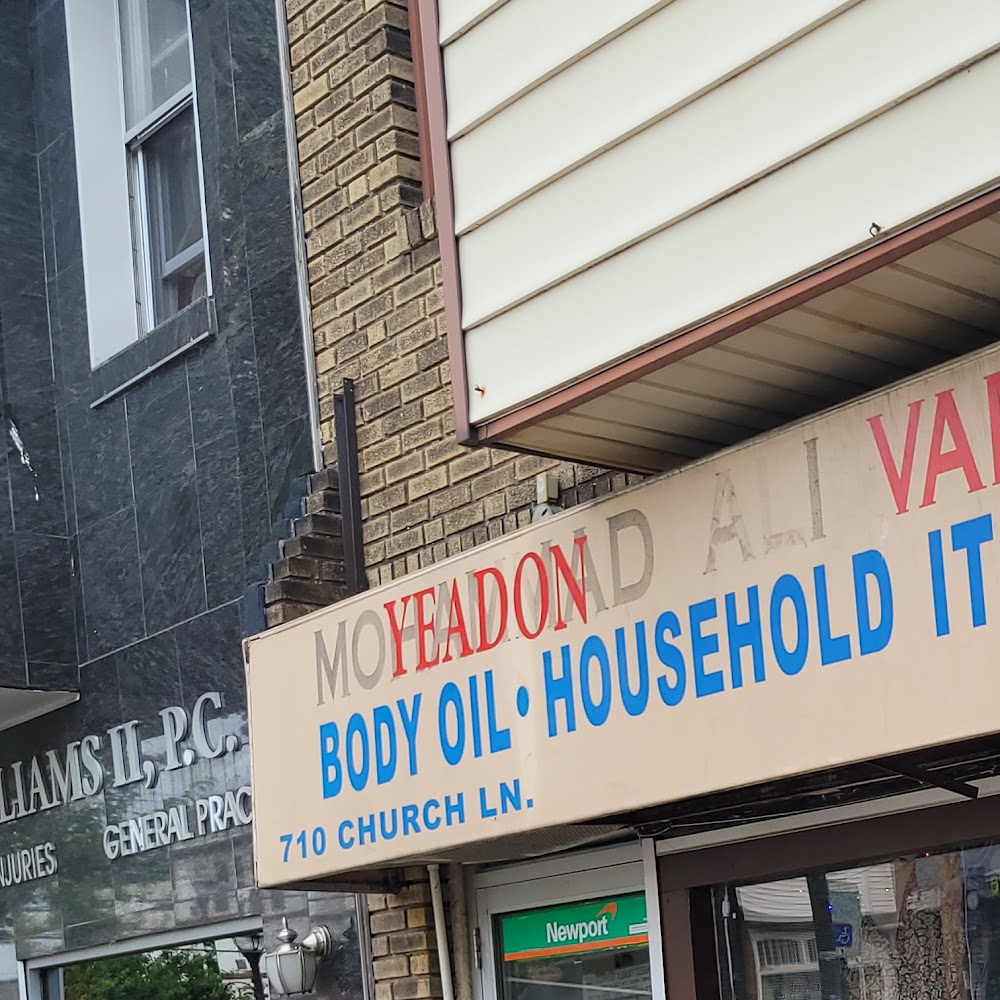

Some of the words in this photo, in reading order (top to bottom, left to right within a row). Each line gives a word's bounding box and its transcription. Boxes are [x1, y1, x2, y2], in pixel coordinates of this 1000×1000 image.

[383, 535, 588, 678] YEADON
[319, 693, 422, 799] BODY
[438, 670, 511, 766] OIL
[542, 549, 894, 737] HOUSEHOLD
[107, 719, 157, 789] II,
[159, 692, 240, 771] P.C.
[103, 805, 195, 860] GENERAL
[279, 826, 326, 864] 710
[338, 793, 465, 849] CHURCH
[479, 779, 534, 818] LN.
[546, 916, 609, 943] Newport
